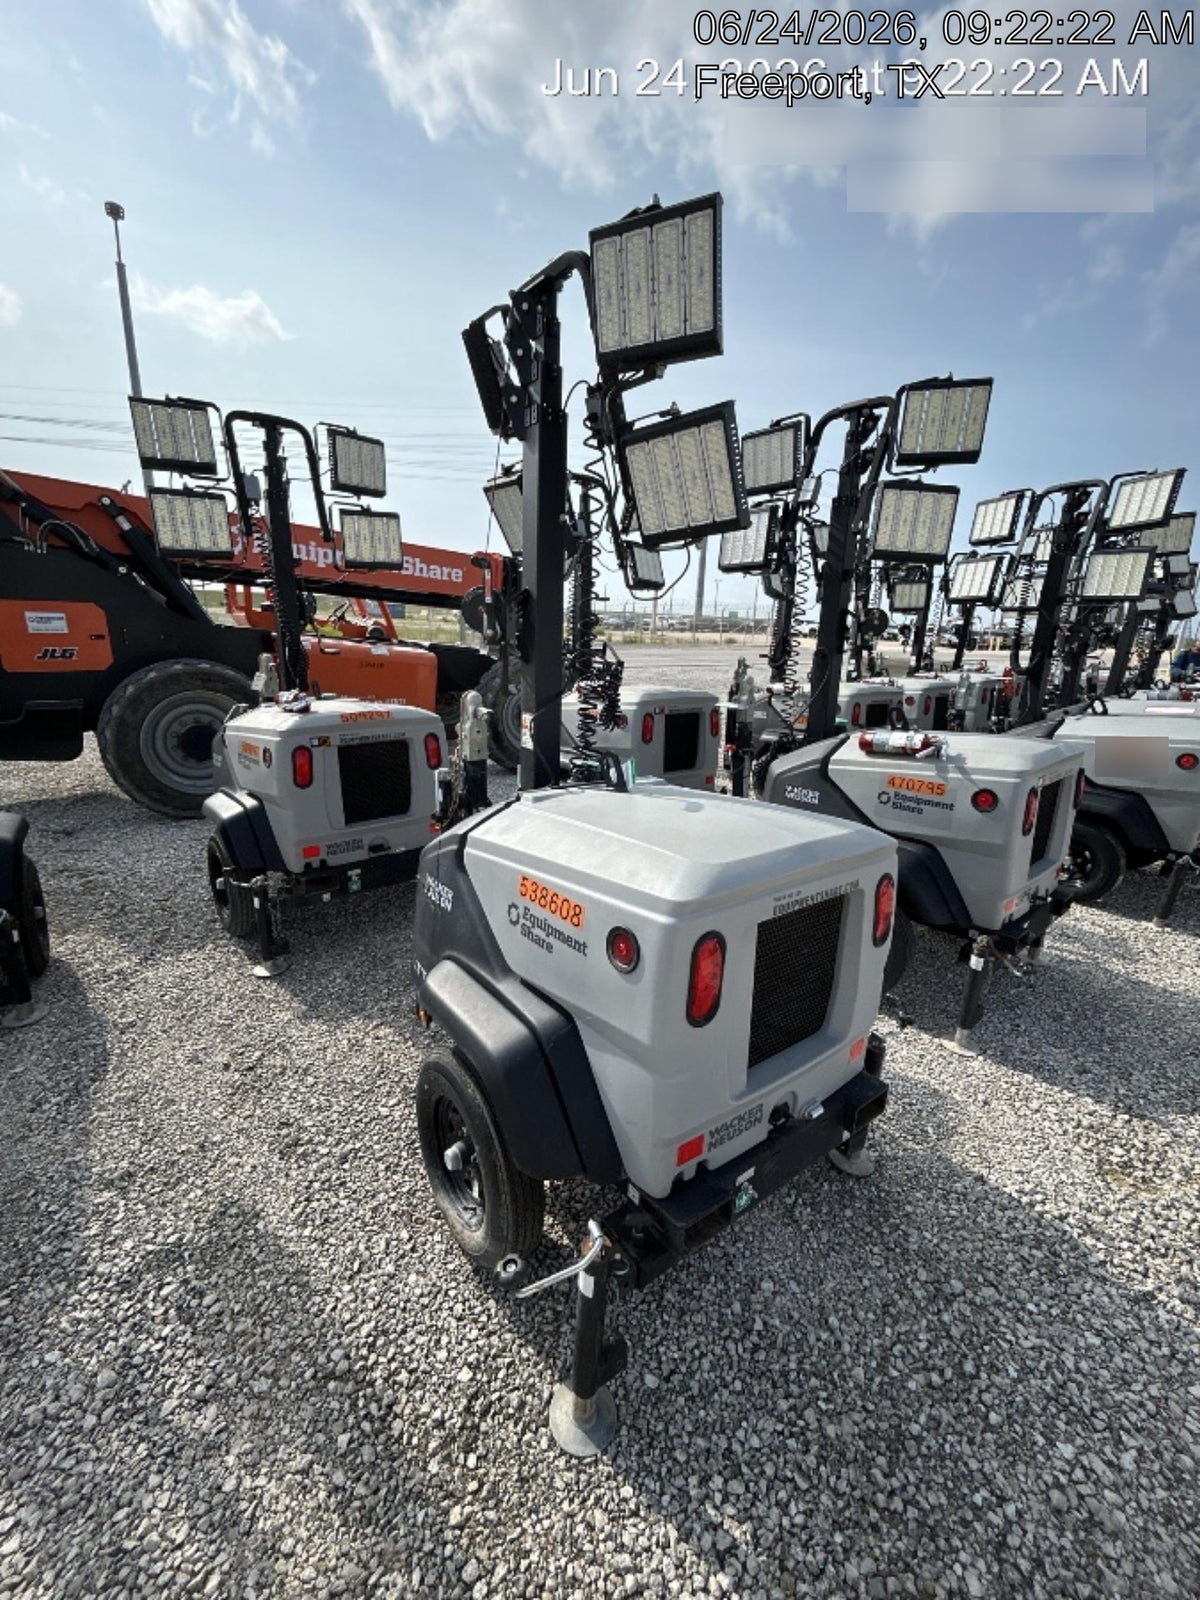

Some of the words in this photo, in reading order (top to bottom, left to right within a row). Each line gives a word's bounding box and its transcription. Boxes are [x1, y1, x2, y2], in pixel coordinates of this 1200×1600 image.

[401, 556, 464, 582] Share
[35, 647, 79, 660] JLG
[887, 776, 946, 796] 470795
[893, 791, 955, 811] Equipment
[520, 875, 583, 928] 538608
[520, 922, 554, 954] Share
[522, 906, 588, 957] Equipment
[707, 1116, 763, 1153] NEUSON
[708, 1103, 764, 1140] WACKER
